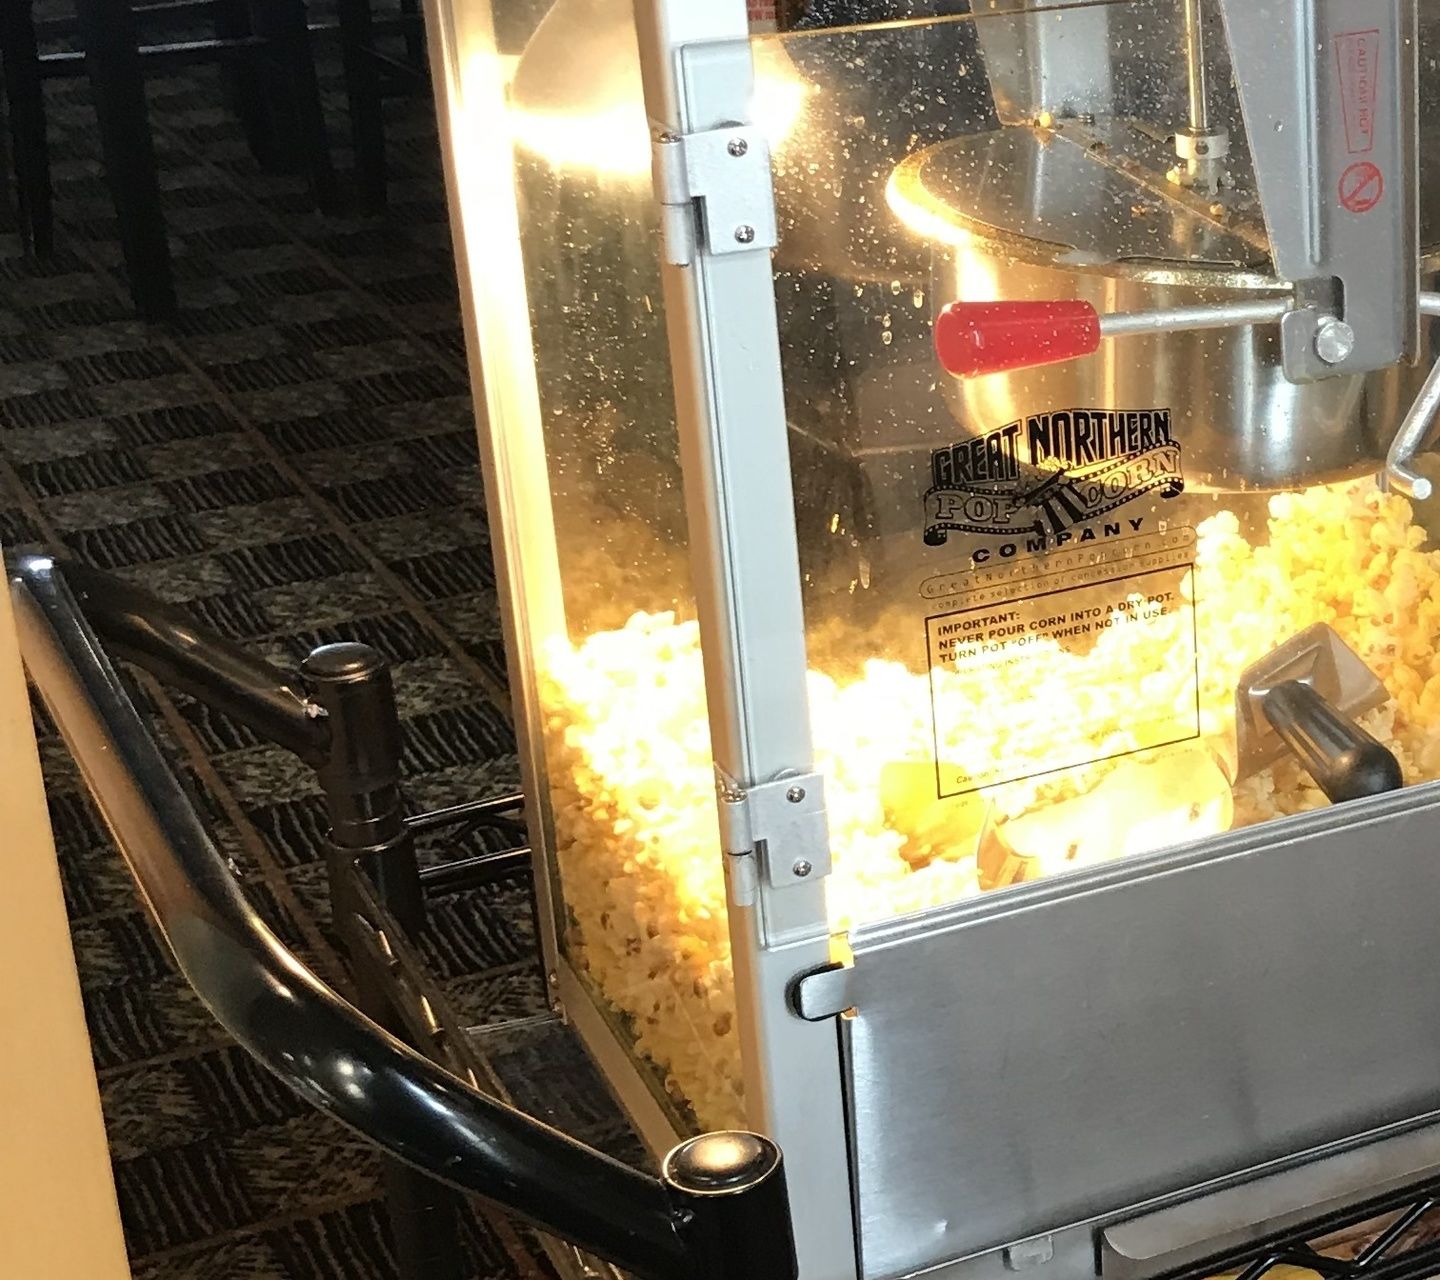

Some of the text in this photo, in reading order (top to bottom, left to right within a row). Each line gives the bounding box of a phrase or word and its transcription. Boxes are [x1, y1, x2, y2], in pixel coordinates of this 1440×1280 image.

[931, 407, 1172, 488] GREAT NORTHERN
[934, 493, 1018, 525] POP
[972, 517, 1145, 563] COMPANY
[937, 611, 1020, 636] IMPORTANT:
[938, 592, 1175, 650] NEVER POUR CORN INTO A DRY POT.
[938, 648, 977, 664] TURN
[982, 641, 1008, 654] POT
[1051, 624, 1091, 639] WHEN
[1095, 616, 1120, 630] NOT
[1125, 612, 1138, 624] IN
